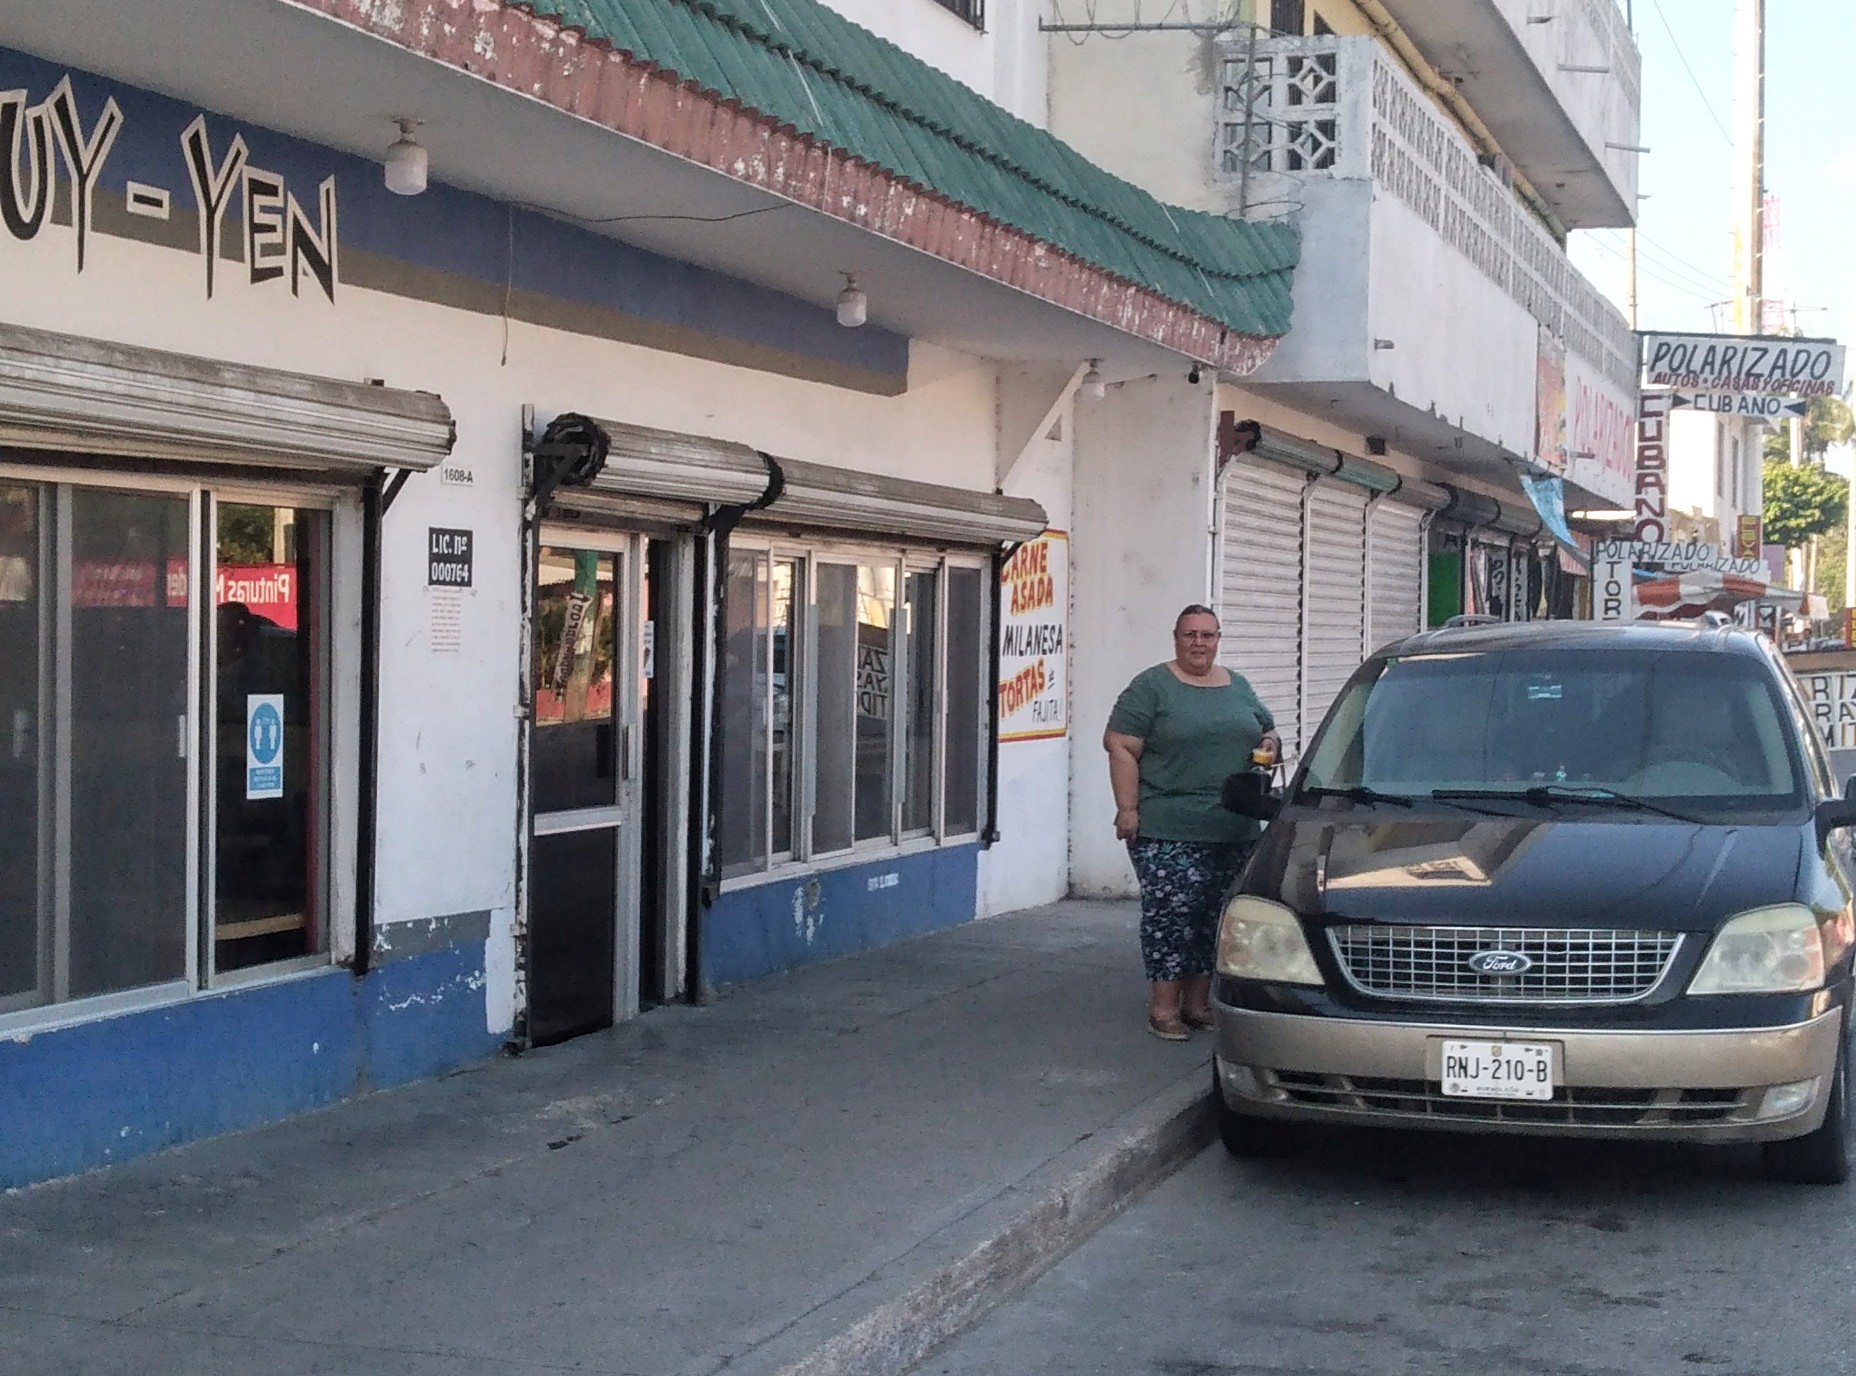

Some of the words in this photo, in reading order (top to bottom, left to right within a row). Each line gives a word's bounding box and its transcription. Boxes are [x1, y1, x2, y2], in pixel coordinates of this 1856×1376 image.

[1649, 341, 1832, 381] POLARIZADO
[1653, 372, 1699, 389] AUTOS
[1772, 378, 1835, 395] OFICINAS
[444, 468, 473, 483] 1608-A
[1634, 394, 1667, 542] CUBANO
[432, 535, 452, 555] LIC.
[1596, 541, 1710, 562] POLARIZADO
[431, 562, 469, 583] 000764
[1010, 575, 1054, 616] ASADA
[1603, 561, 1623, 620] TOR
[1002, 623, 1063, 657] MILANESA
[999, 657, 1047, 719] TORTAS
[1482, 955, 1518, 971] Ford
[1446, 1055, 1548, 1083] RNJ-210-B
